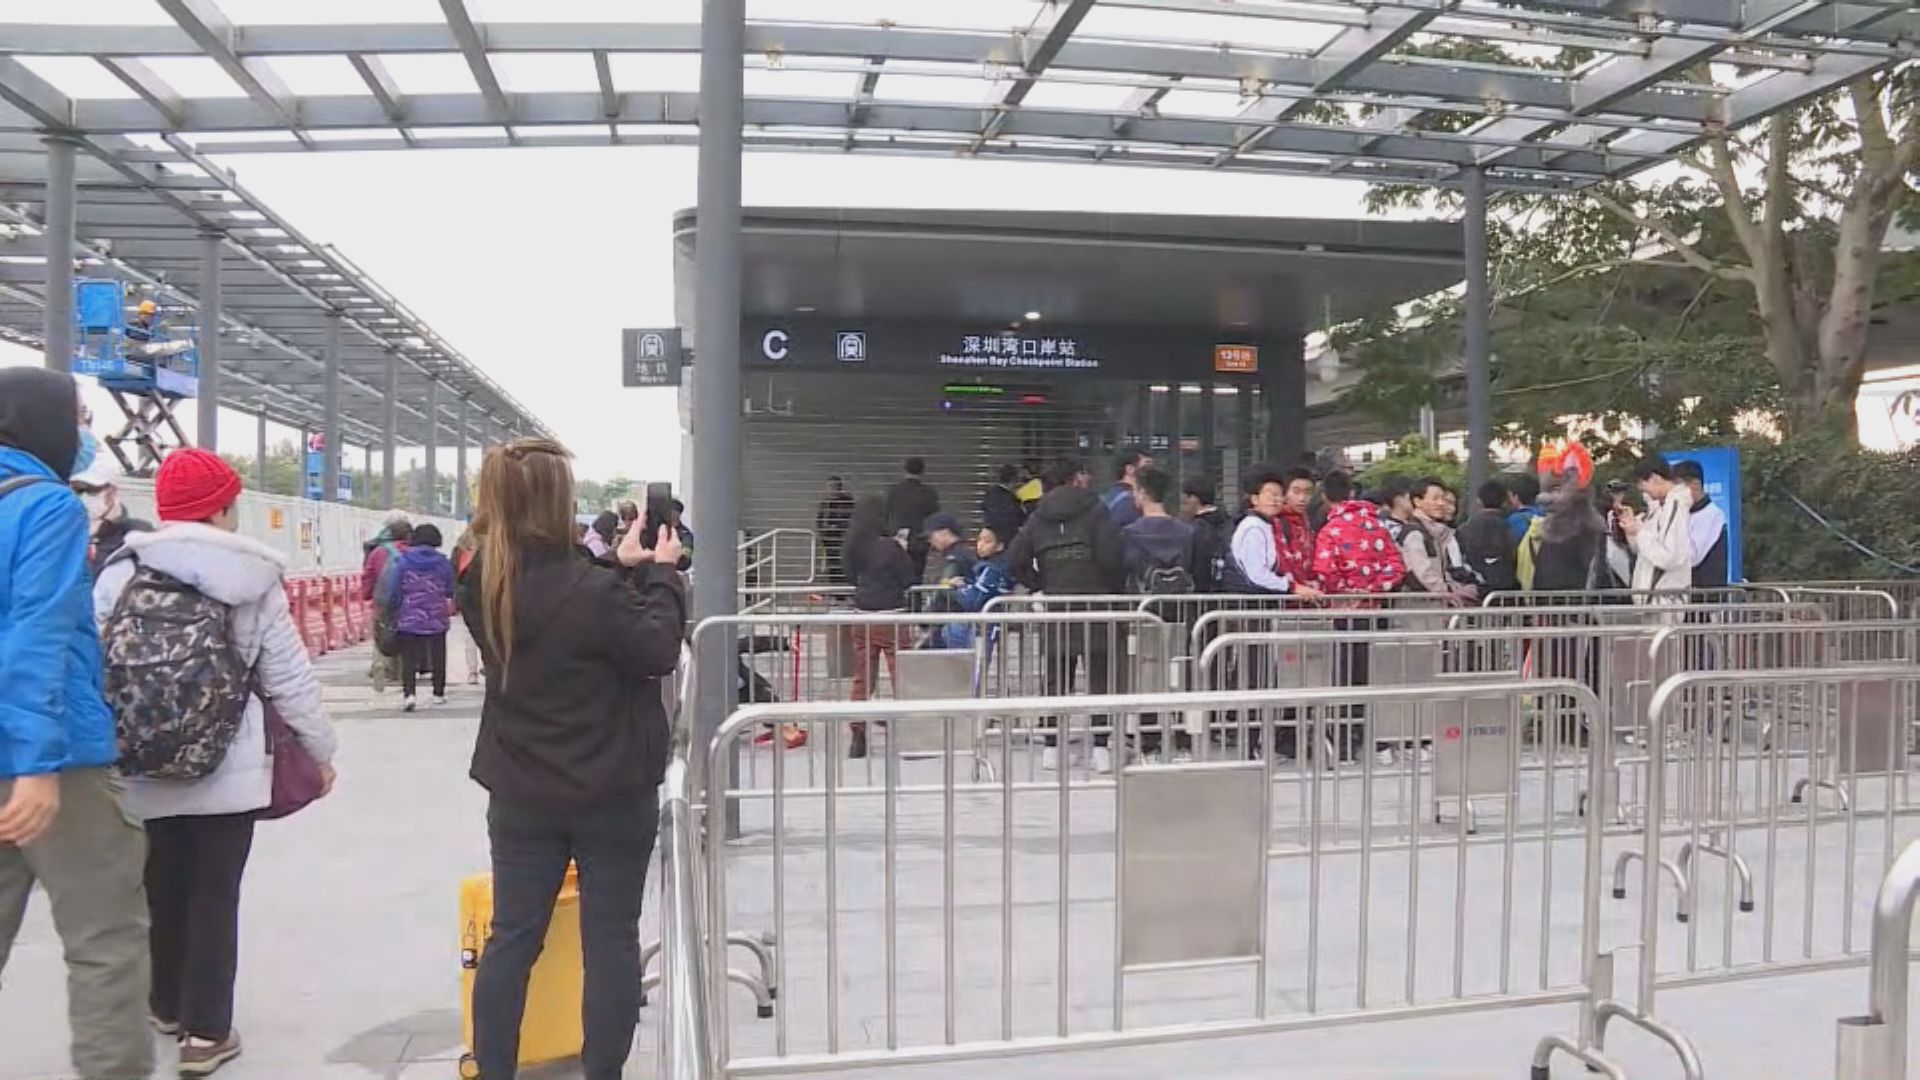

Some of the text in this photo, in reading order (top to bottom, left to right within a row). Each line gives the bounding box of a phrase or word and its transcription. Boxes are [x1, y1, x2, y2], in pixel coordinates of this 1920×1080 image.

[763, 330, 788, 360] C
[962, 336, 1077, 356] 深圳湾口岸站
[989, 356, 1008, 367] Bay
[1009, 356, 1064, 367] Checkpoint
[1065, 358, 1098, 367] Station
